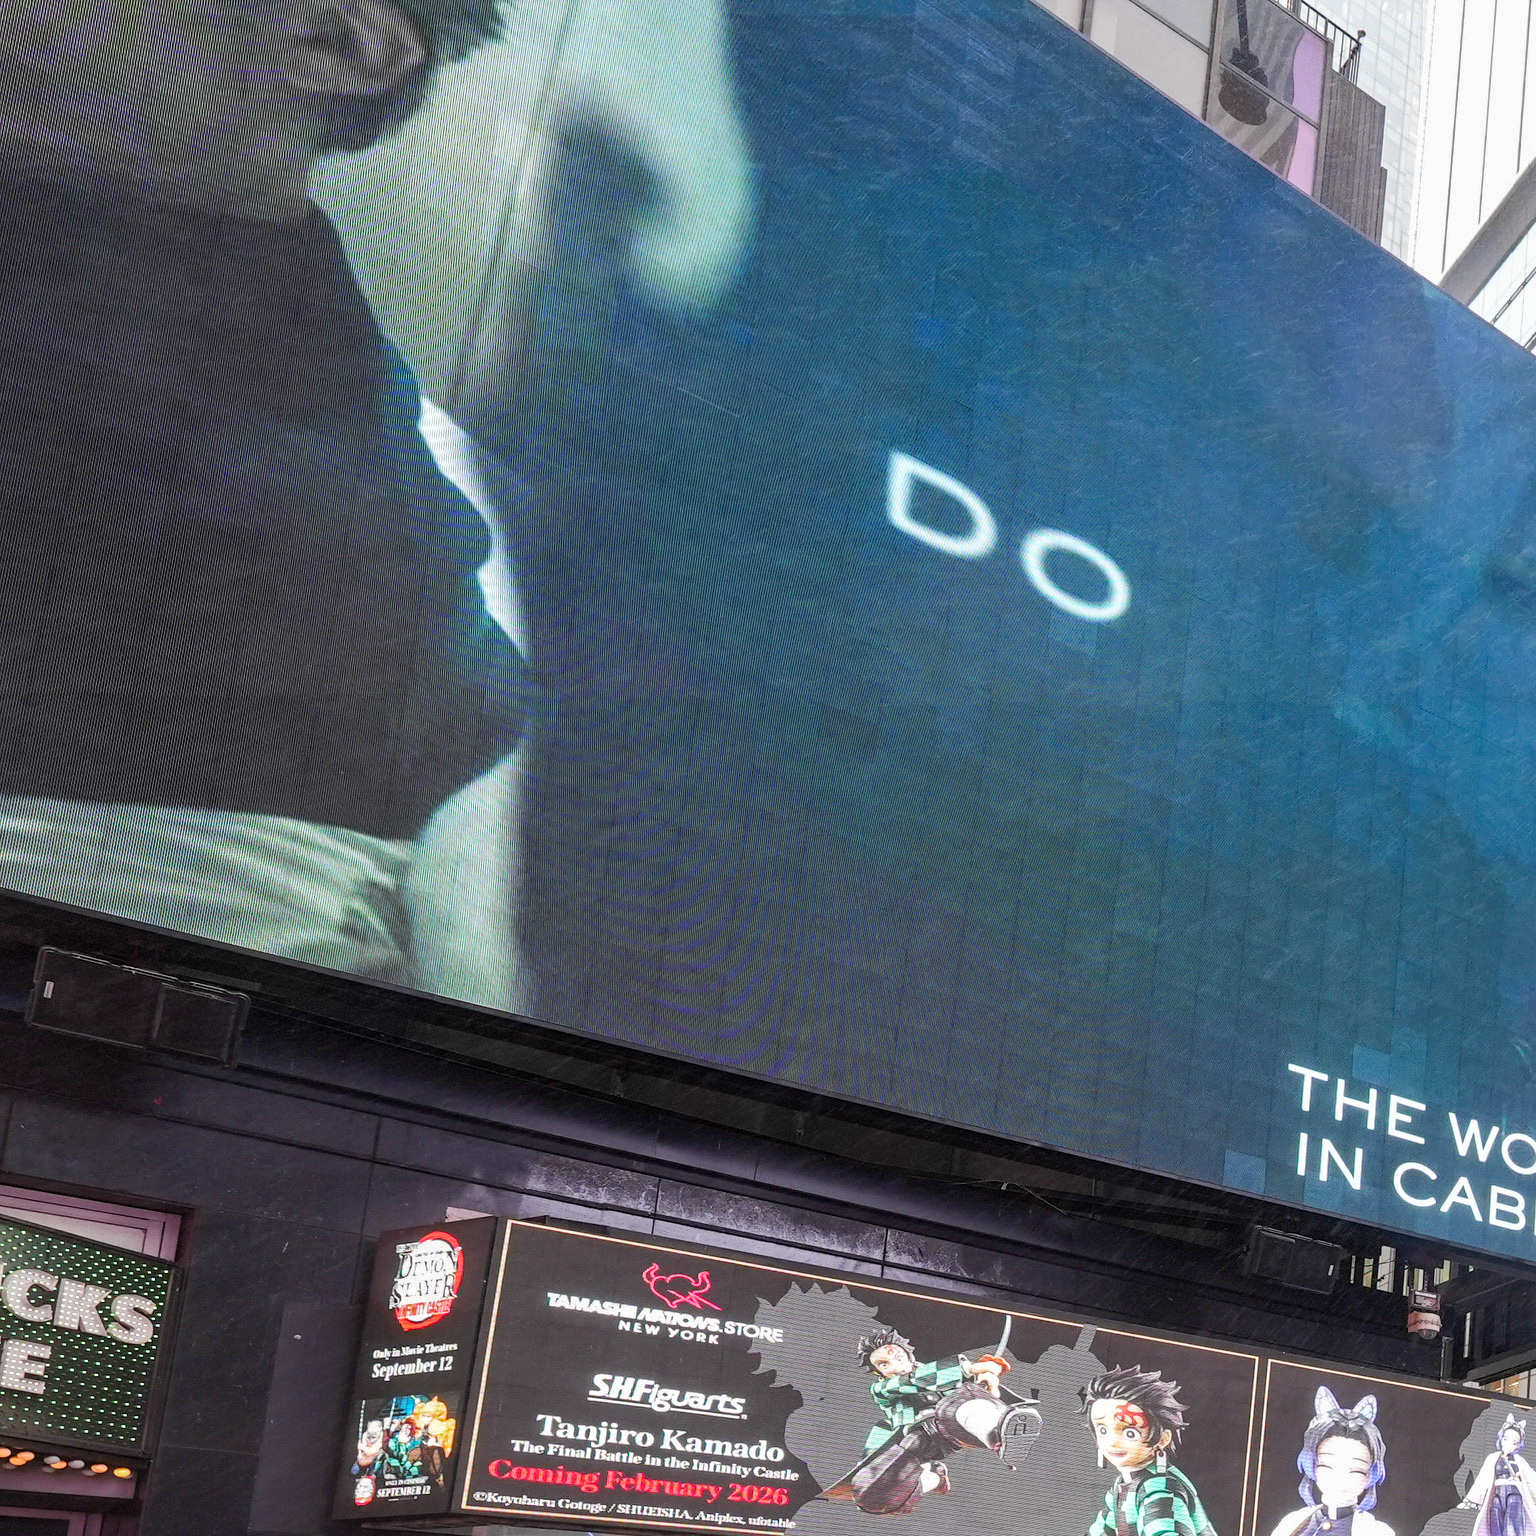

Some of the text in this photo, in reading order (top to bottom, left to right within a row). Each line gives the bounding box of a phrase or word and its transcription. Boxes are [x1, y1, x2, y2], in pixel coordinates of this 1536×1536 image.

[885, 448, 1133, 624] DO
[1287, 1064, 1425, 1144] THE
[1297, 1133, 1363, 1191] IN
[0, 1266, 156, 1344] CKS
[618, 1320, 719, 1345] NEW YORK
[724, 1321, 784, 1343] STORE
[0, 1338, 51, 1395] E
[371, 1356, 453, 1381] September 12
[511, 1439, 799, 1482] The Final Battle in the Infinity Castle
[536, 1413, 784, 1462] Tanjiro Kamado
[377, 1486, 422, 1498] SEPTEMBER
[488, 1459, 789, 1506] Coming February 2026
